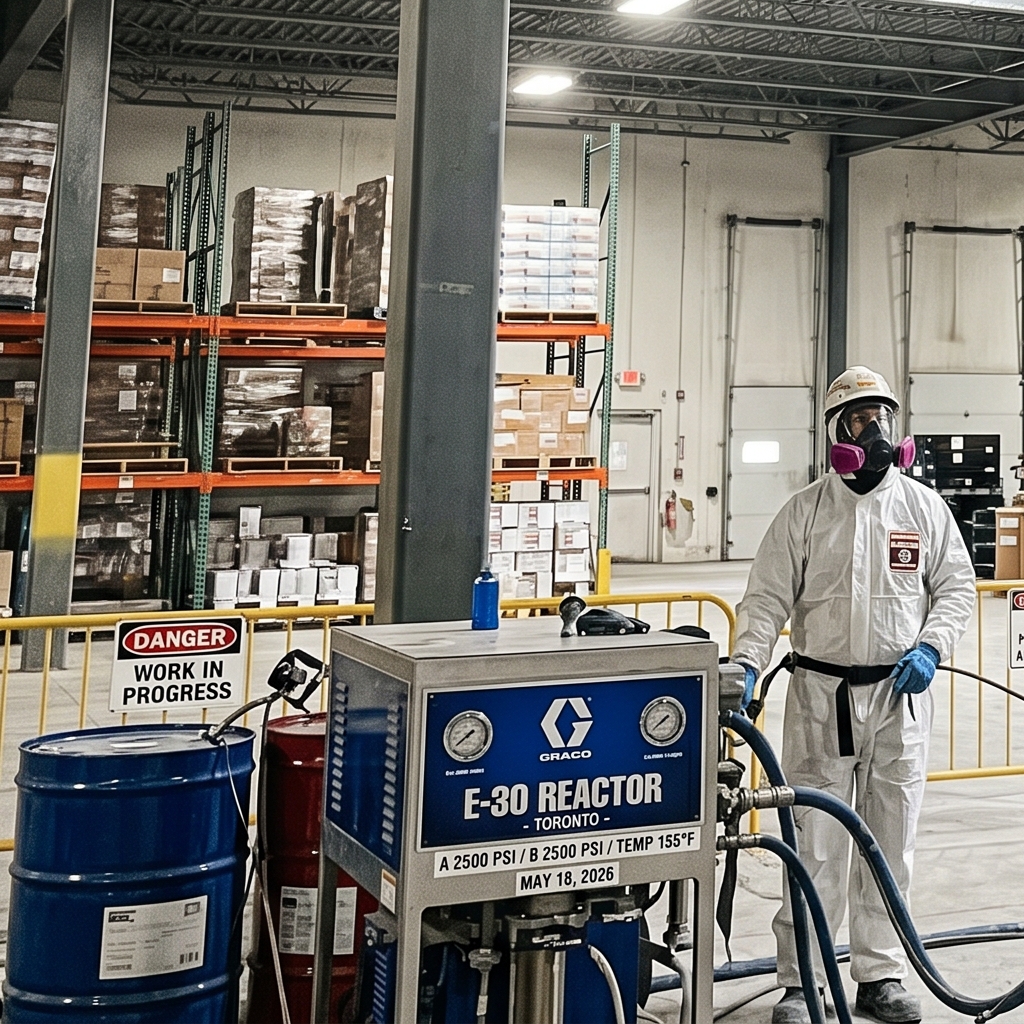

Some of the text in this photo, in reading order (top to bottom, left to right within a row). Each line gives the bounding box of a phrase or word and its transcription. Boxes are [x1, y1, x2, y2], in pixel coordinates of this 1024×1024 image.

[134, 629, 226, 650] DANGER
[134, 660, 224, 682] WORK IN
[122, 682, 232, 705] PROGRESS
[539, 750, 592, 762] GRACO
[463, 772, 662, 820] E-30 REACTOR
[534, 812, 600, 832] TORONTO
[439, 831, 695, 872] A 2500 PSI / B 2500 PSI / TEMP 155°F
[520, 866, 614, 891] MAY 18, 2026
